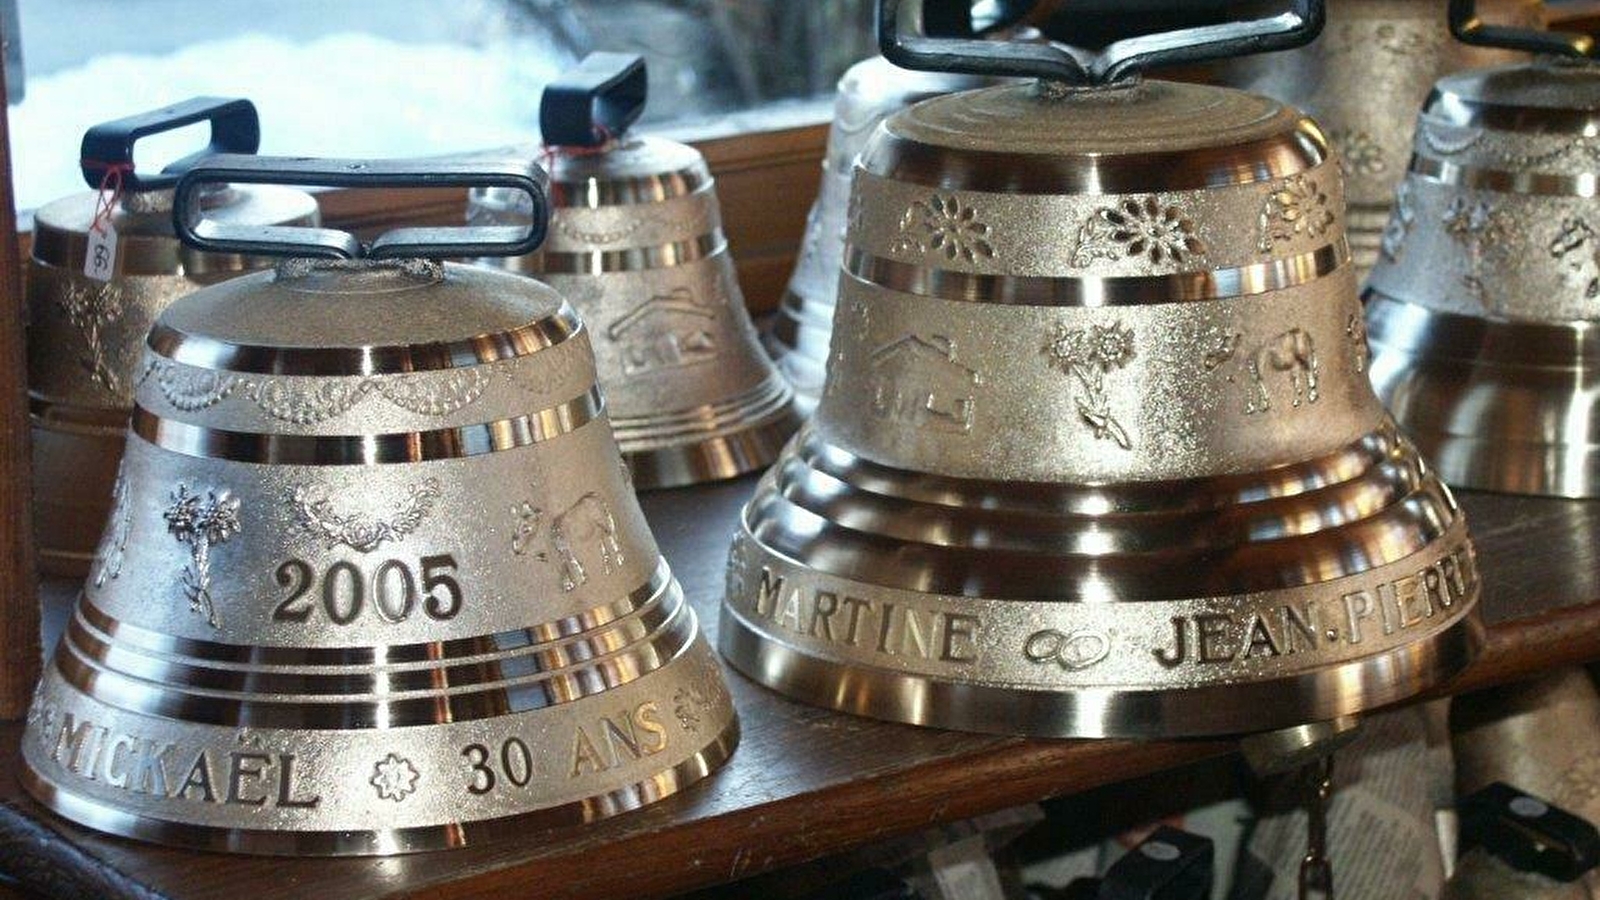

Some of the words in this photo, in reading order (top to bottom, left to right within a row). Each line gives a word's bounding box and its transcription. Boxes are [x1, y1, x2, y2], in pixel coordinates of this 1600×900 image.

[274, 553, 463, 626] 2005
[751, 565, 981, 663] MARTINE
[54, 711, 320, 808] MICKAËL
[459, 736, 533, 796] 30
[567, 702, 667, 779] ANS
